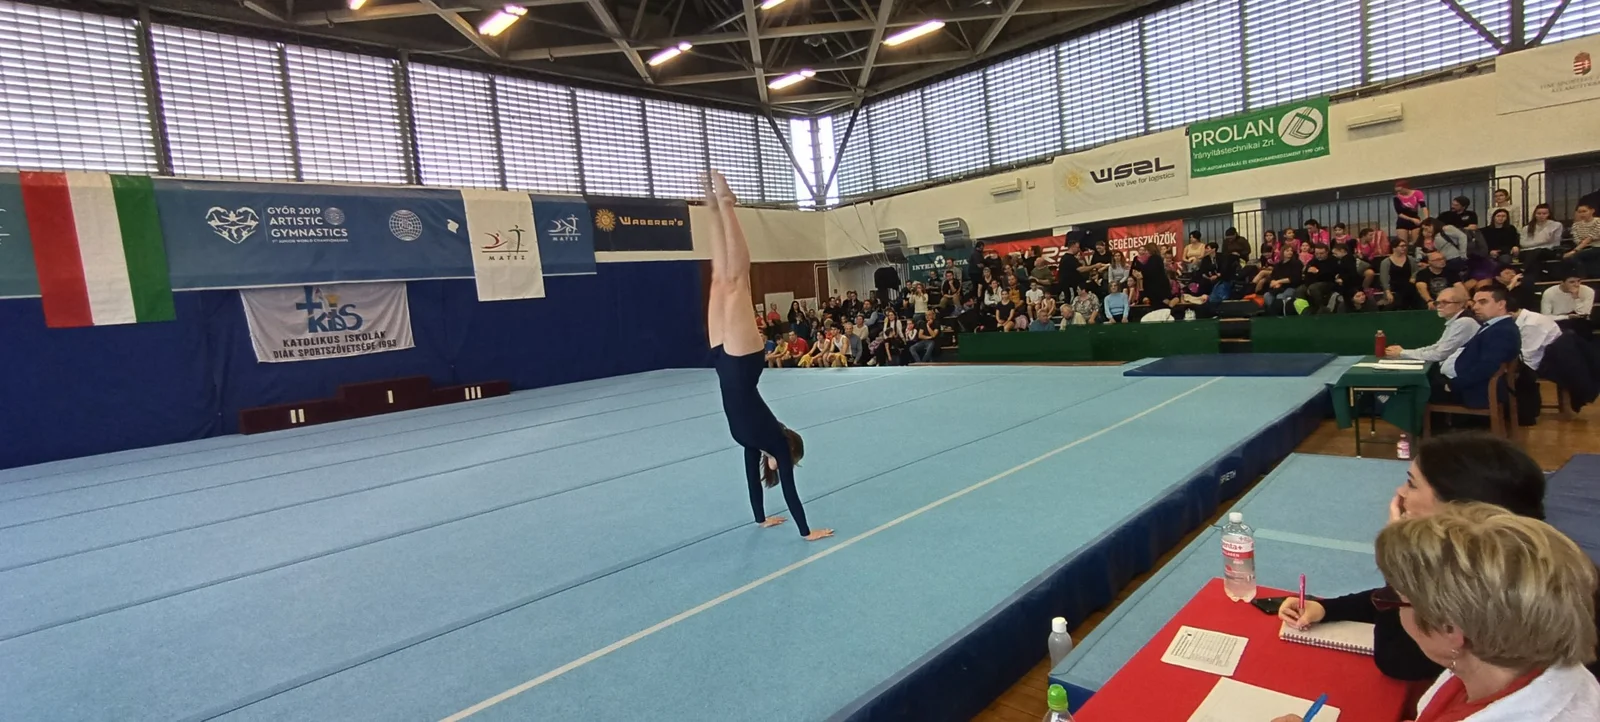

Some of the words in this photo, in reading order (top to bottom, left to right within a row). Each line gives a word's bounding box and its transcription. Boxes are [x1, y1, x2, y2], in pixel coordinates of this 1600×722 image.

[1191, 117, 1274, 149] PROLAN
[1138, 176, 1148, 184] for
[1148, 172, 1175, 183] logistics
[267, 205, 296, 215] GYŐR
[298, 207, 321, 215] 2019
[269, 216, 324, 226] ARTISTIC
[271, 228, 348, 237] GYMNASTICS
[1108, 231, 1177, 251] SEGÉDESZKÖZÖK
[283, 335, 340, 348] KATOLIKUS
[344, 330, 387, 343] ISKOLÁK
[273, 349, 295, 359] DIÁK
[297, 343, 376, 357] SPORTSZÖVETSÉGE
[377, 339, 397, 349] 1993
